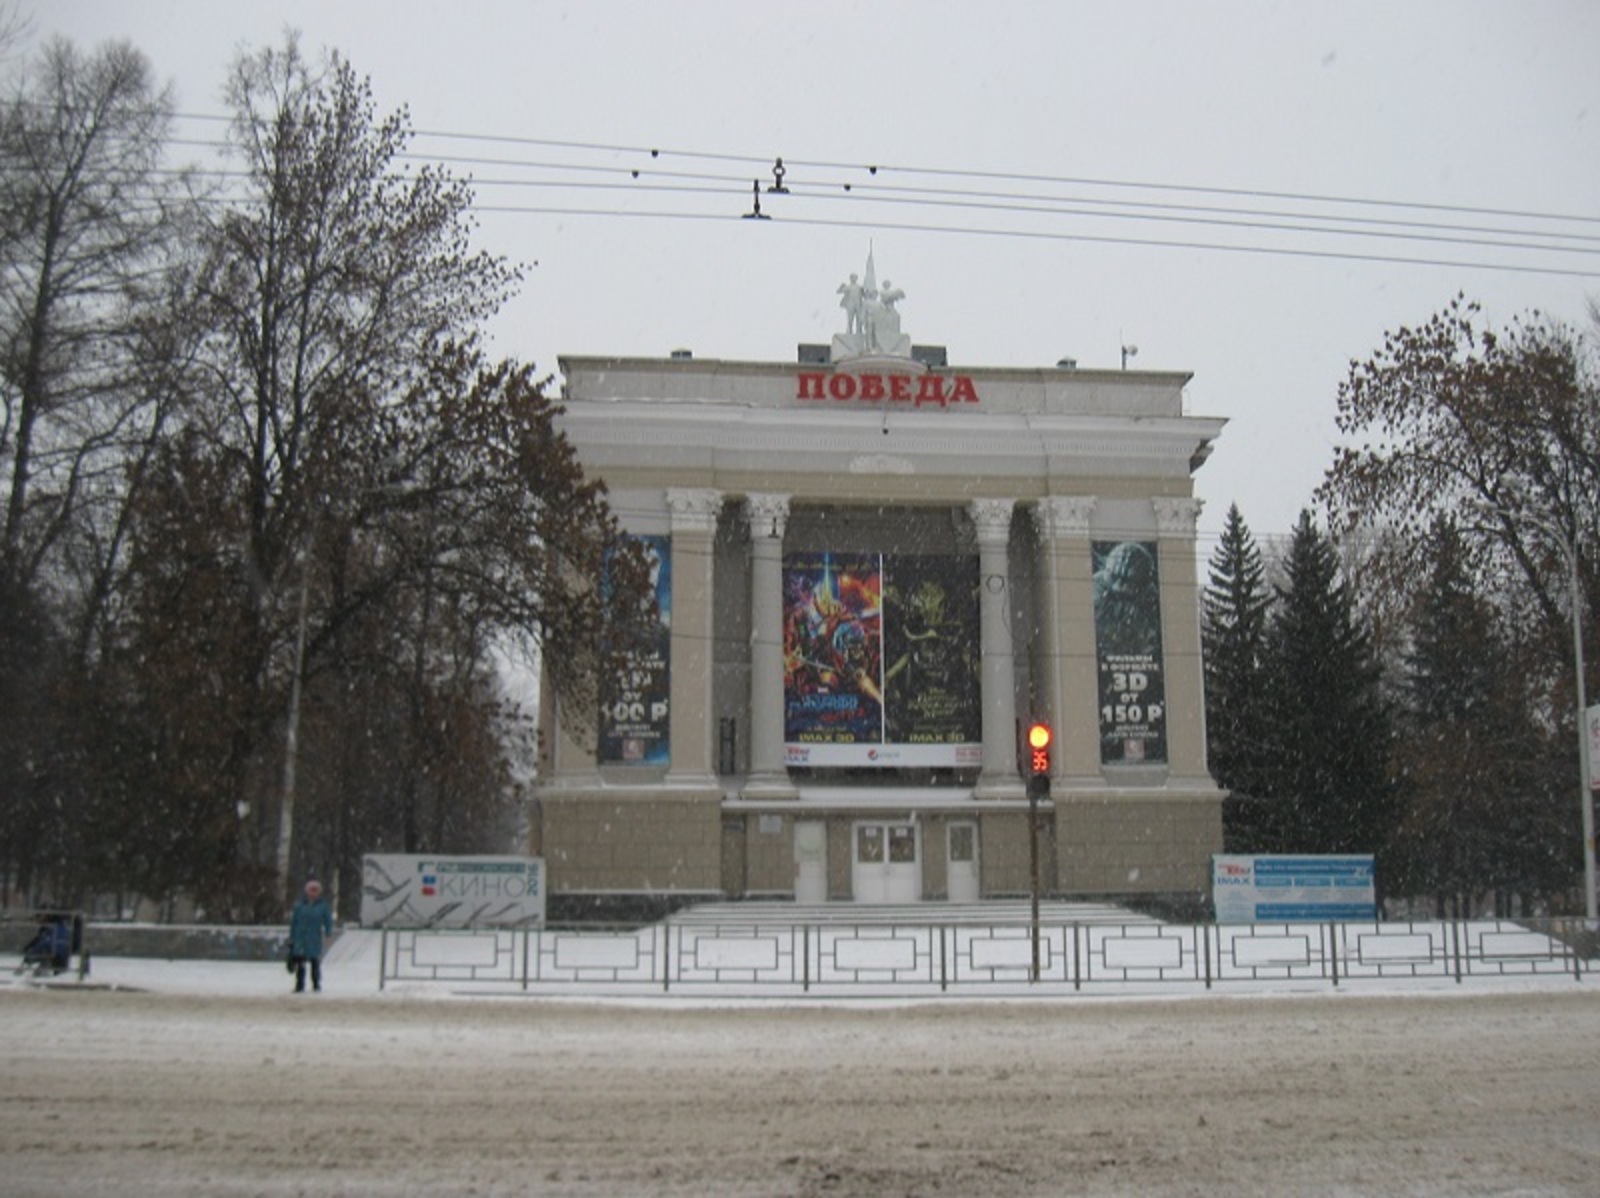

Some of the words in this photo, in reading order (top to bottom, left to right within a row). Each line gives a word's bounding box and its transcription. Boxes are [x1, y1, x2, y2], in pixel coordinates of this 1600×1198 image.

[796, 371, 979, 408] ПОБЕДА
[1113, 672, 1148, 691] 3D
[1120, 692, 1139, 703] ОТ
[1102, 704, 1143, 723] 150
[439, 875, 527, 898] КИНО
[1217, 876, 1251, 886] IMAX
